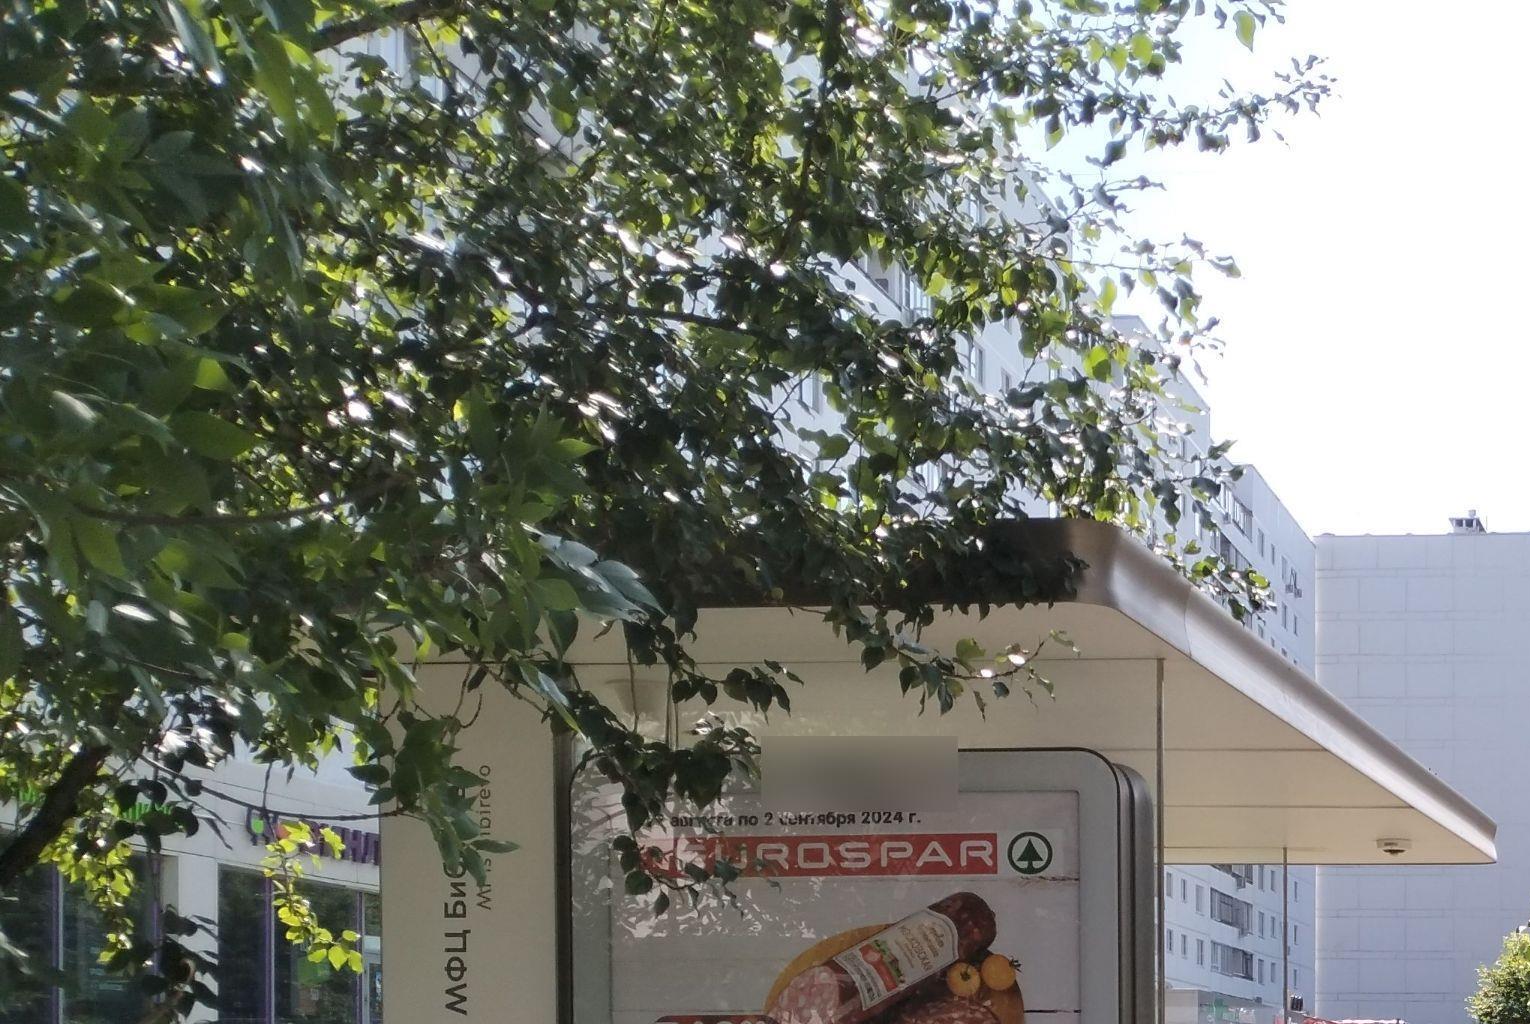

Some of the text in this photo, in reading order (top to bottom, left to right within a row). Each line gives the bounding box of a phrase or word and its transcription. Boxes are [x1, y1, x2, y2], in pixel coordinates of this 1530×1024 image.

[477, 764, 492, 839] ibireo
[738, 815, 759, 826] по
[764, 811, 774, 826] 2
[861, 811, 904, 825] 2024
[908, 811, 922, 825] г.
[444, 929, 472, 1016] МФЦ
